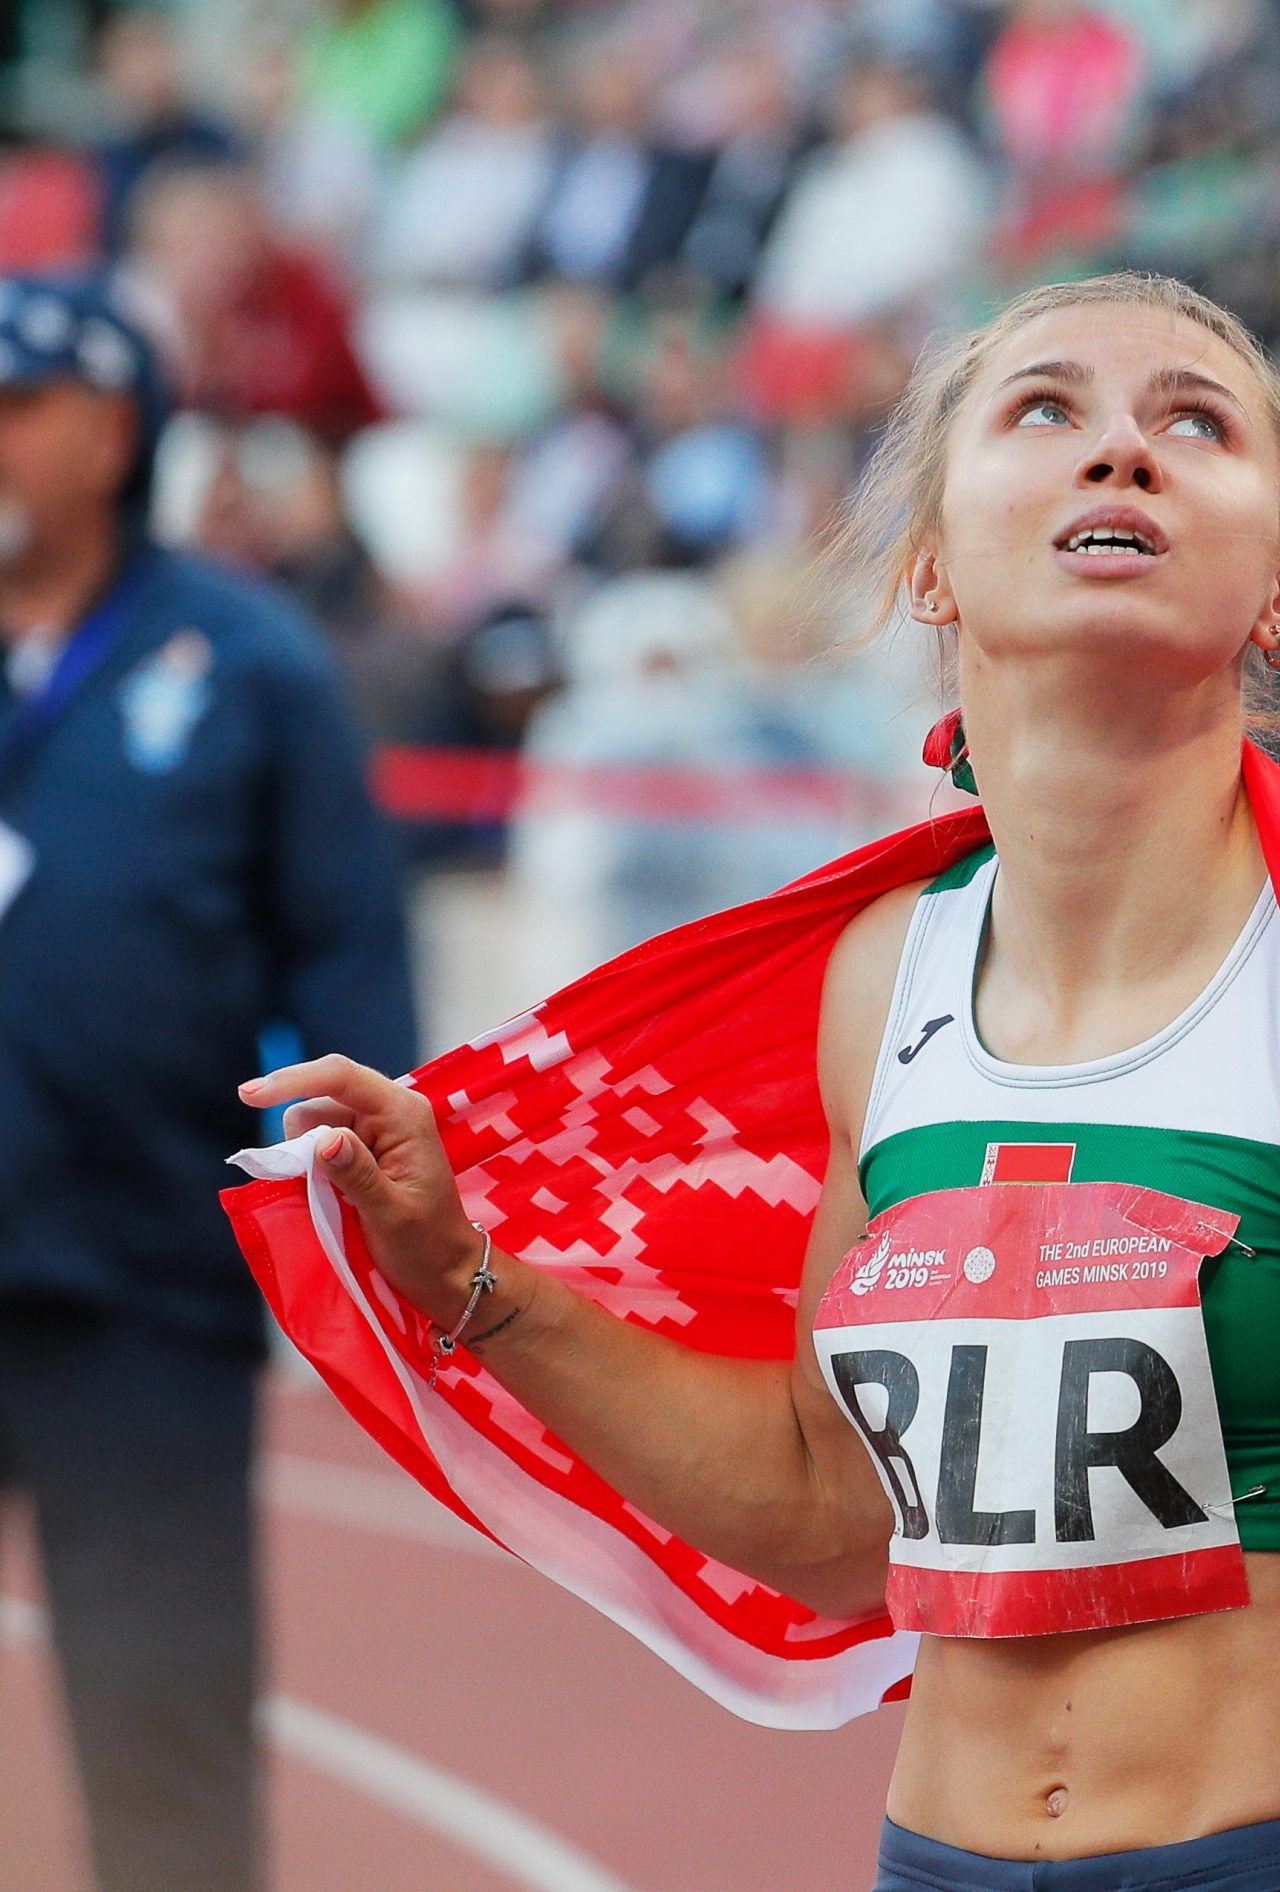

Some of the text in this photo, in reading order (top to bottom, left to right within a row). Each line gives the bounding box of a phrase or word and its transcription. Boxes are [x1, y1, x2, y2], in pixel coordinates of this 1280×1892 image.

[1039, 1236, 1173, 1262] THE 2nd EUROPEAN
[884, 1267, 929, 1290] 2019
[1035, 1260, 1168, 1289] GAMES MINSK 2019
[830, 1337, 1210, 1546] BLR
